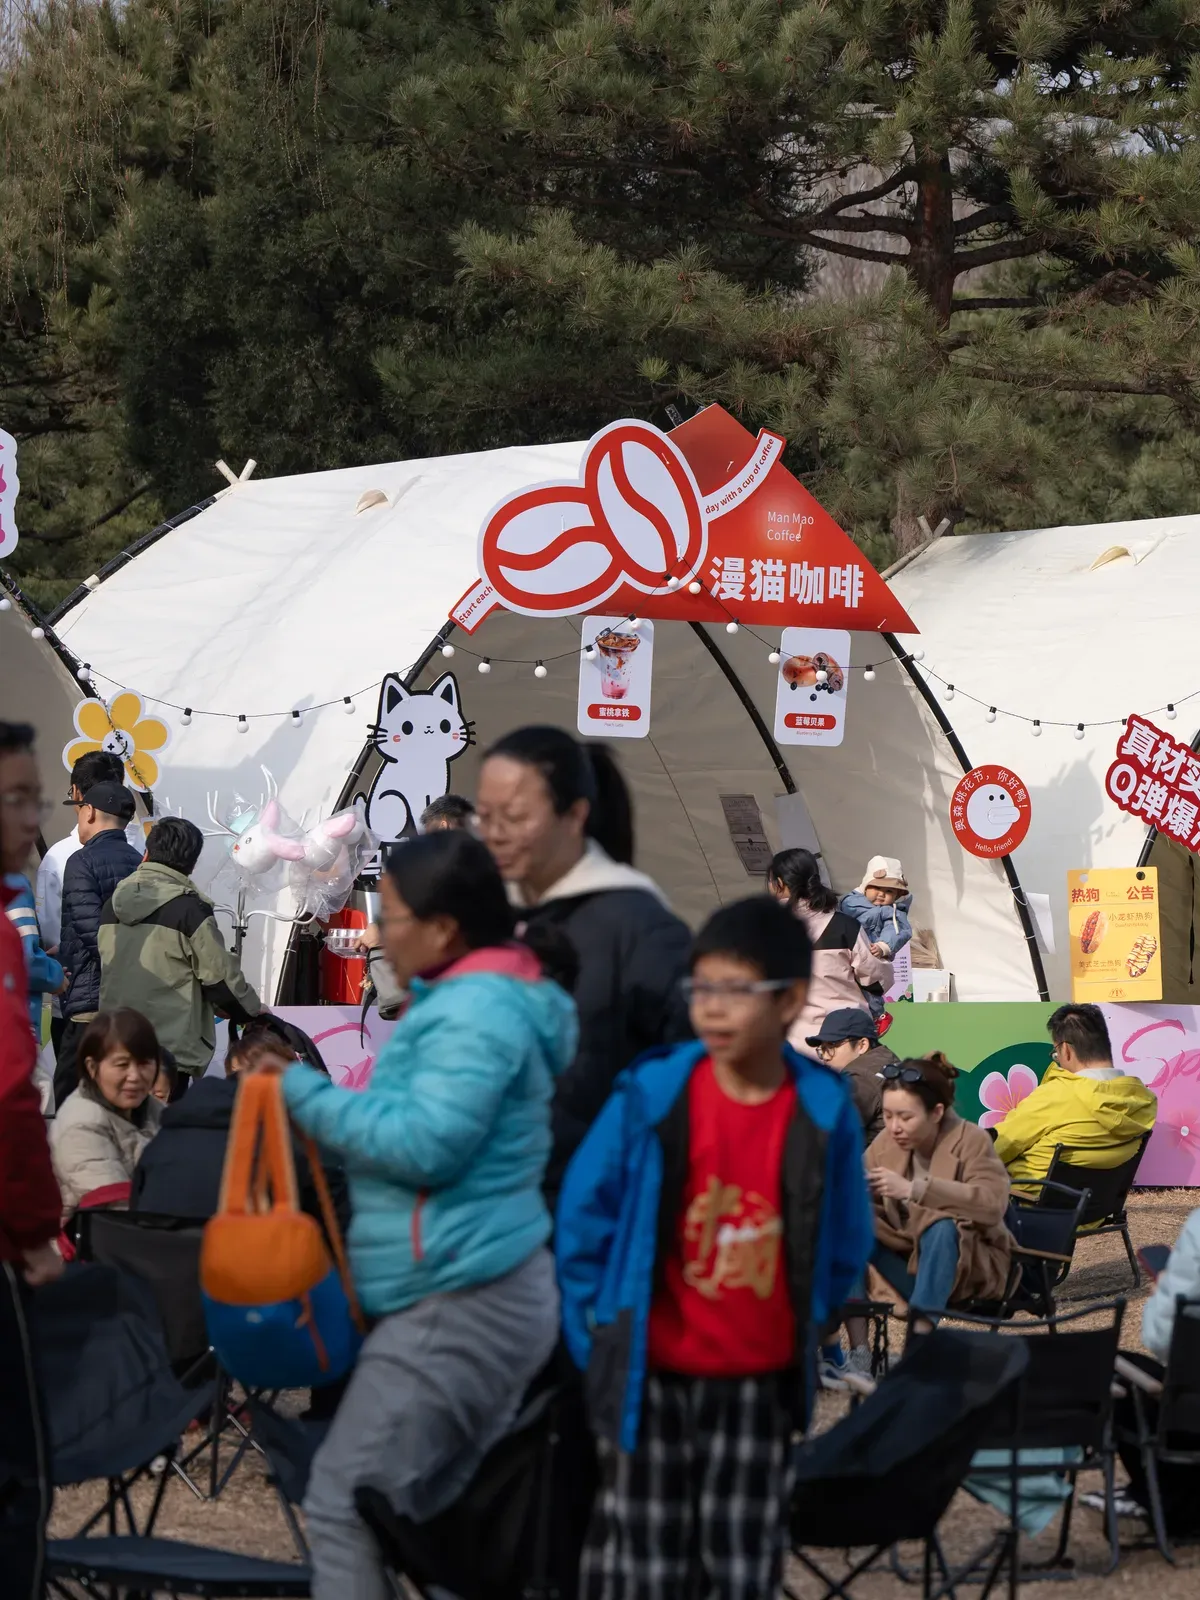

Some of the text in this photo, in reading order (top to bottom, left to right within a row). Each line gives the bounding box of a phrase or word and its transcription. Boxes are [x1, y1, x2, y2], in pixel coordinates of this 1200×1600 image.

[705, 502, 720, 515] day
[720, 491, 738, 506] with
[742, 474, 755, 489] cup
[754, 463, 761, 475] of
[759, 438, 774, 465] coffee
[767, 511, 814, 525] Man Mao
[767, 529, 802, 542] Coffee
[709, 556, 864, 608] 漫猫咖啡
[459, 586, 493, 623] Start each
[599, 707, 630, 718] 蜜桃拿铁
[795, 716, 825, 727] 蓝莓贝果
[1071, 888, 1100, 903] 热狗
[1126, 885, 1155, 901] 公告
